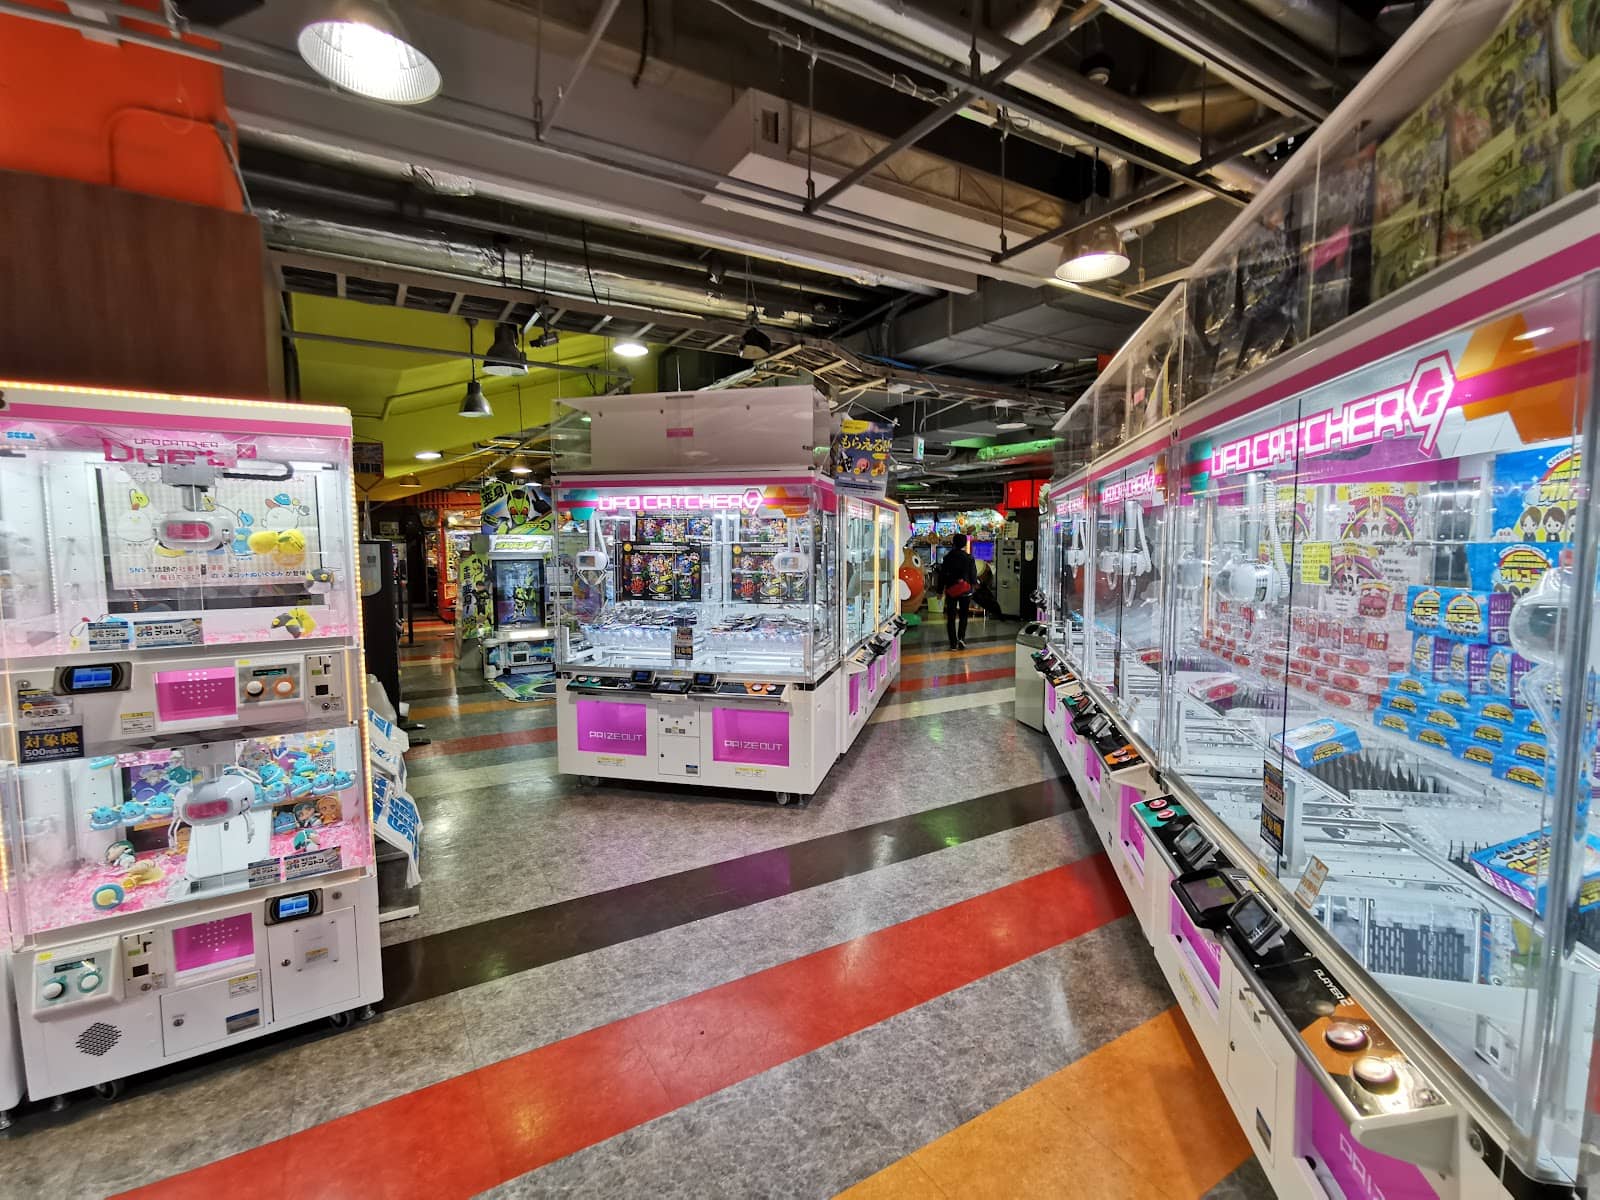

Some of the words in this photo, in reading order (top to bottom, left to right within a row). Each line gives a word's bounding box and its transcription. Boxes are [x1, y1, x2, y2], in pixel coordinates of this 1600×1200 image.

[6, 431, 36, 440] SEGA
[1211, 439, 1250, 479] UFO
[1252, 388, 1406, 468] CATCHER
[134, 438, 162, 446] UFO
[163, 439, 218, 449] CATCHER
[597, 495, 641, 511] UFO
[643, 494, 743, 510] CATCHER
[1313, 967, 1346, 1000] PLAYER
